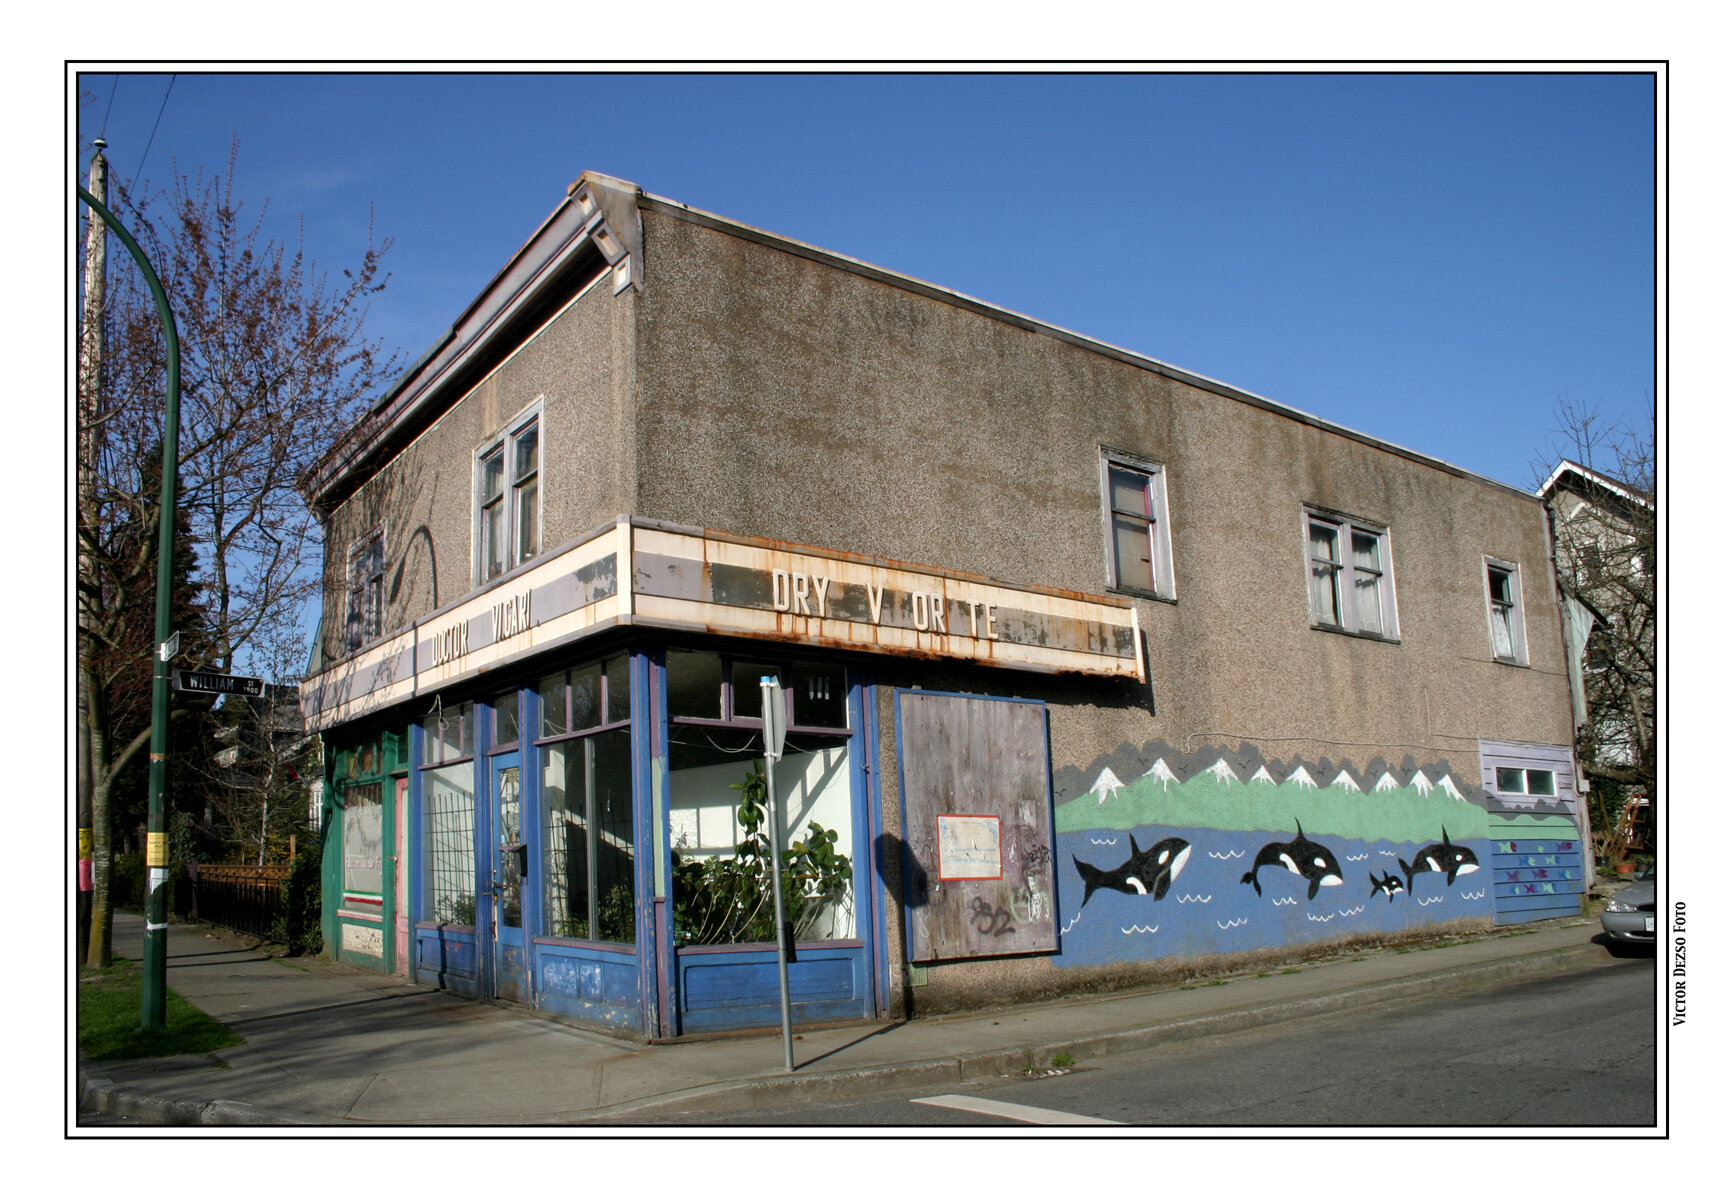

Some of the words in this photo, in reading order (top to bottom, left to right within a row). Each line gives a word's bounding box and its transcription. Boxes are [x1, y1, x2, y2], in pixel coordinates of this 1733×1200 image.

[772, 568, 830, 618] DRY
[865, 582, 885, 625] V
[911, 590, 947, 634] OR
[966, 600, 1000, 640] TE
[432, 619, 469, 668] DOCTOR
[190, 676, 234, 691] WILLIAM
